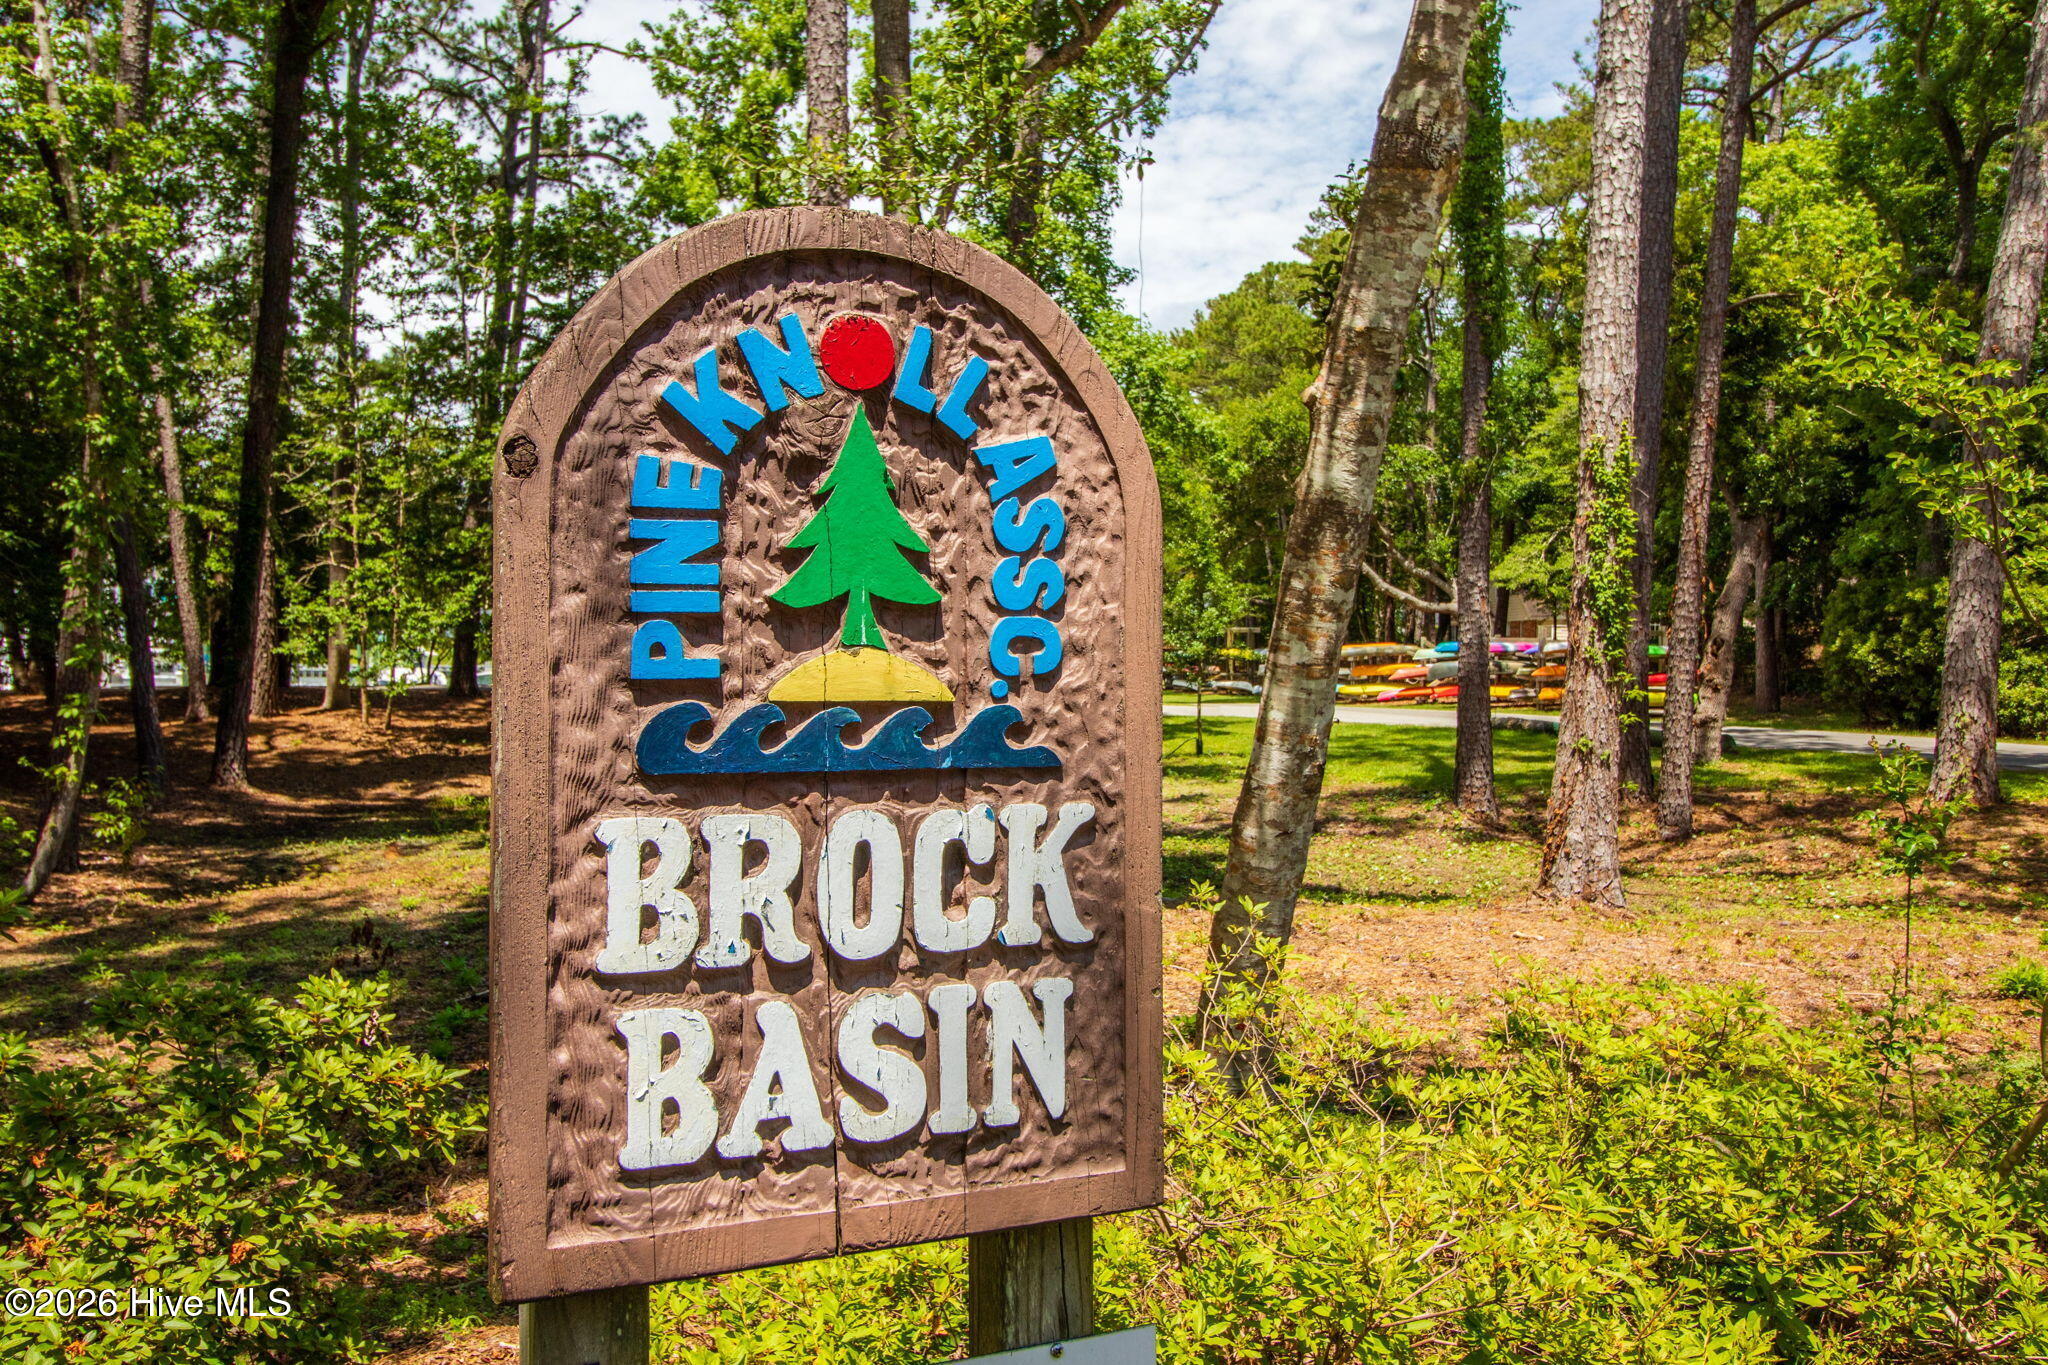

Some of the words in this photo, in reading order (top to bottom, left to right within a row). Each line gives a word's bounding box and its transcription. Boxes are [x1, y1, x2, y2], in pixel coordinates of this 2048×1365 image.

[661, 312, 989, 456] KNOLL
[629, 455, 723, 680] PINE
[974, 435, 1066, 699] ASSC.
[594, 802, 1096, 974] BROCK
[615, 977, 1074, 1170] BASIN
